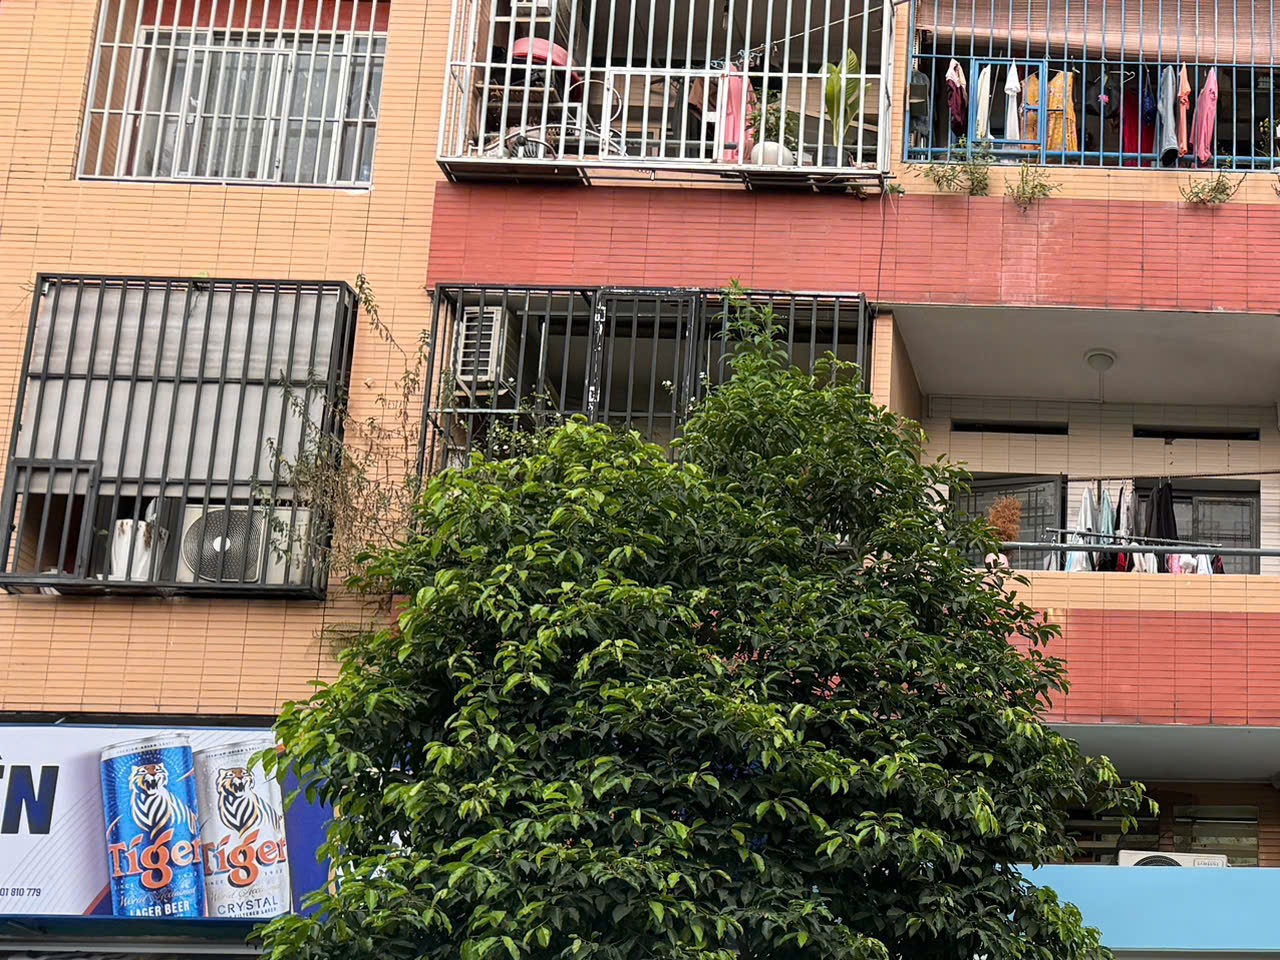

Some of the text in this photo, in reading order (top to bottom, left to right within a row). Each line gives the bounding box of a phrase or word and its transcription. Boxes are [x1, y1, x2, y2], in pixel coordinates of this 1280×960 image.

[0, 755, 60, 835] N
[109, 828, 201, 889] Tiger
[203, 829, 287, 888] Tiger
[11, 887, 25, 897] 810
[27, 888, 41, 897] 779
[164, 900, 190, 914] BEER
[217, 895, 279, 915] CRYSTAL
